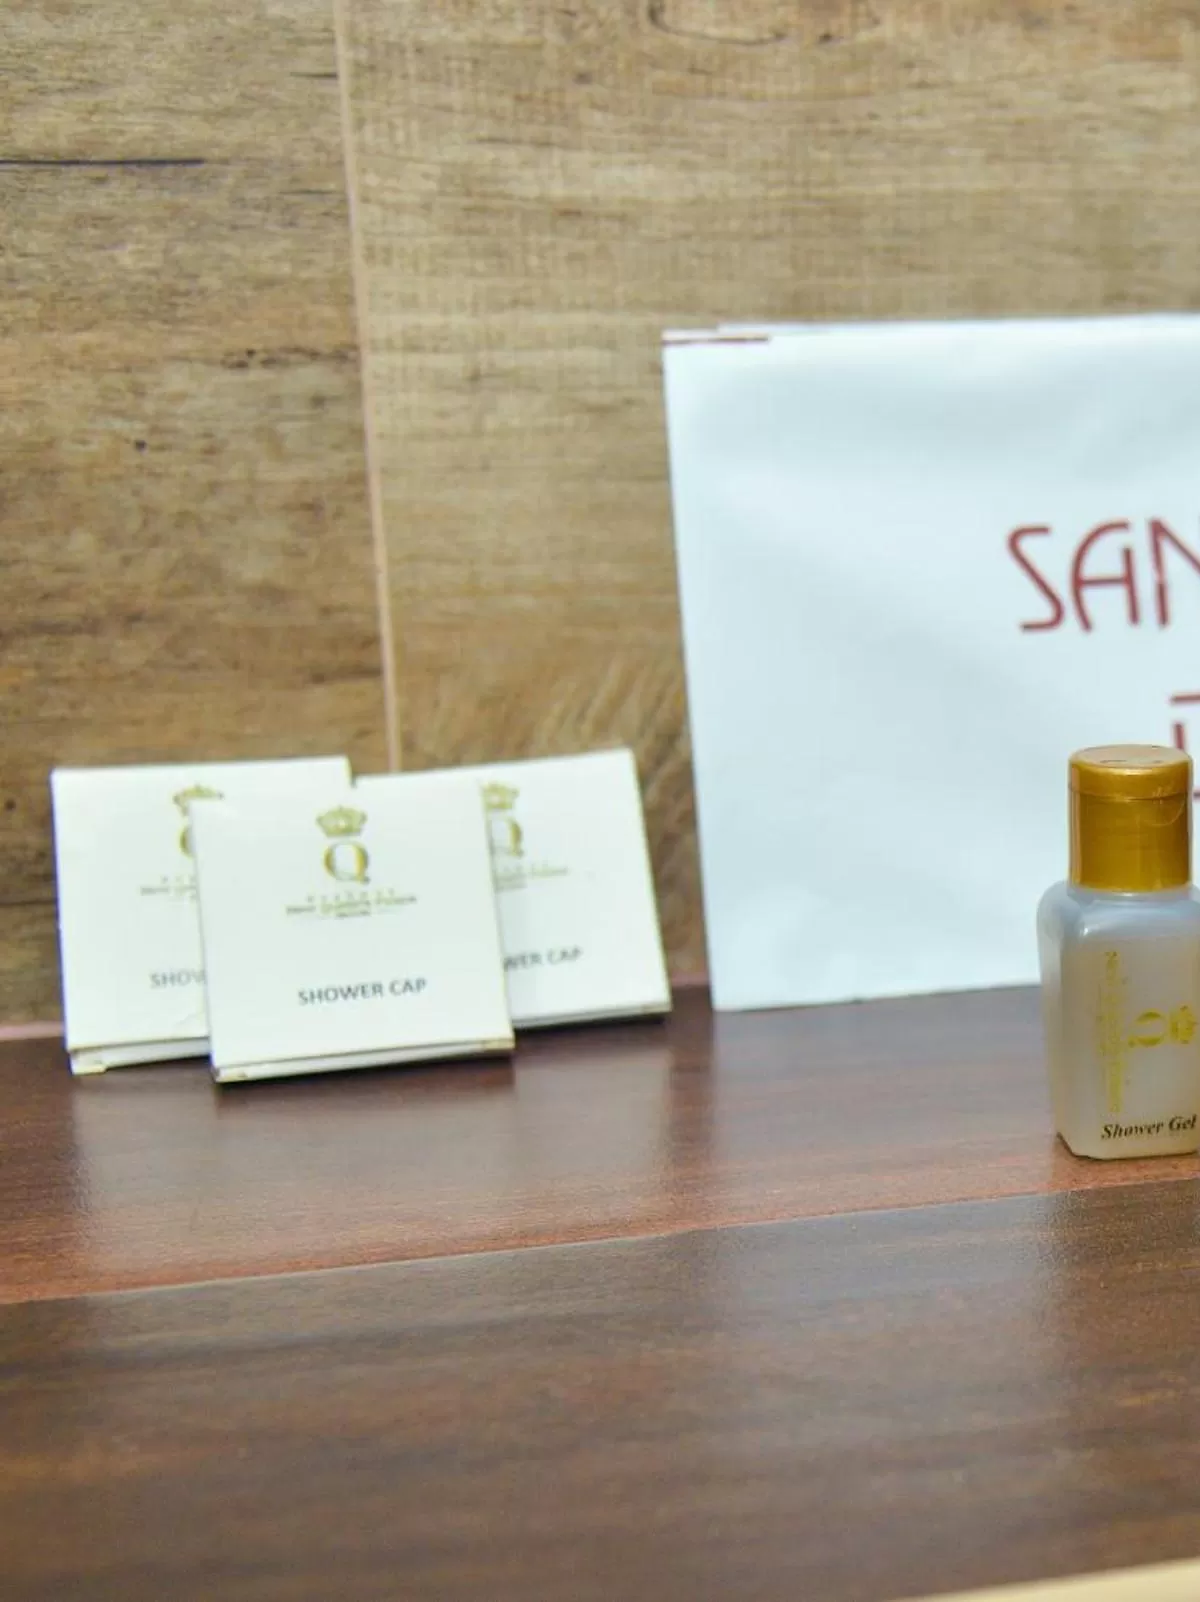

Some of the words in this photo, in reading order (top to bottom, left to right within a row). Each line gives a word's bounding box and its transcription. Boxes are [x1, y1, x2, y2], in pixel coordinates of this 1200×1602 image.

[298, 980, 384, 1006] SHOWER
[388, 976, 428, 997] CAP
[1101, 1121, 1164, 1139] Shower
[1169, 1113, 1197, 1131] Gel
